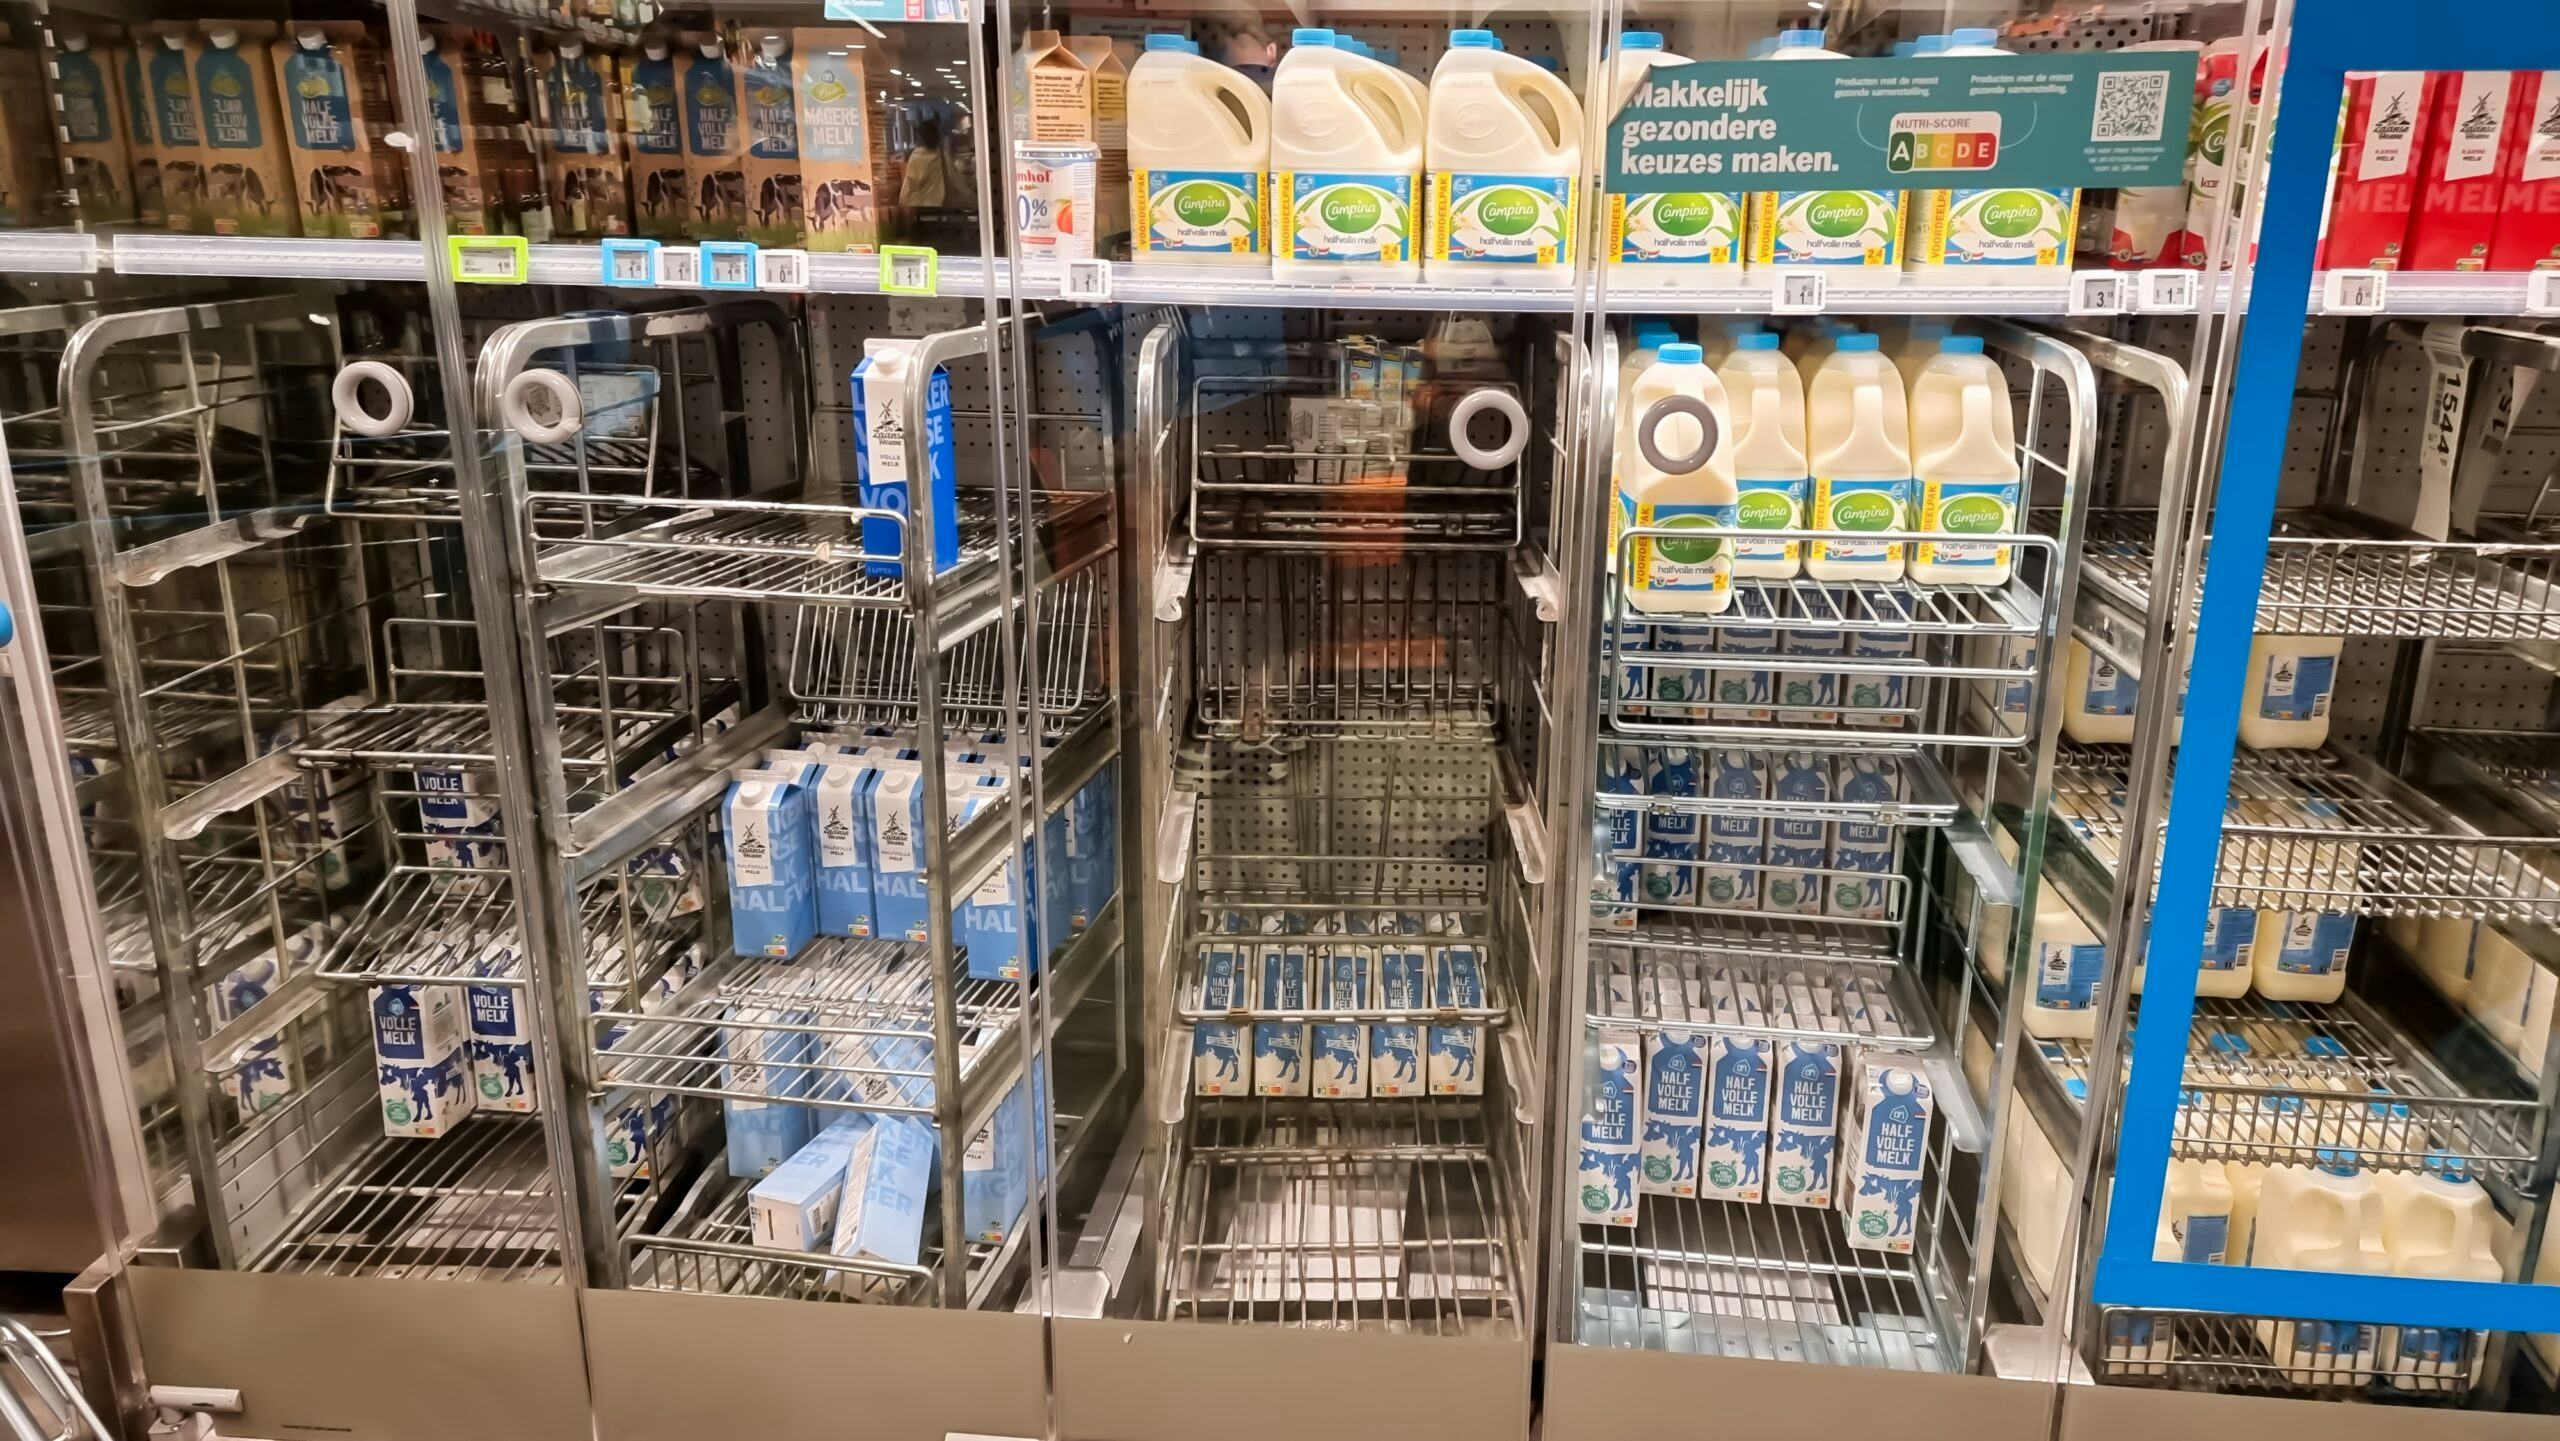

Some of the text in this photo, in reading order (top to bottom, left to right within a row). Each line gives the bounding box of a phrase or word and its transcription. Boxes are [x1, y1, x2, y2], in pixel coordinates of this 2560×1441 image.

[1626, 78, 1768, 112] Makkelijk
[804, 107, 859, 126] MAGERE
[1896, 118, 1971, 129] NUTRI-SCORE
[813, 126, 854, 145] MELK
[1622, 112, 1777, 147] gezondere
[1891, 141, 1990, 161] A B C D E
[1621, 145, 1839, 175] keuzes maken.
[1138, 174, 1146, 246] VOORDEELPAK
[1178, 196, 1225, 215] Campina
[1325, 200, 1376, 221] Campina
[1483, 202, 1534, 222] Campina
[1282, 177, 1290, 253] VOORDEELPAK
[1436, 178, 1448, 255] VOORDEELPAK
[1658, 204, 1709, 223] Campina
[1811, 204, 1864, 224] Campina
[1984, 204, 2038, 224] Campina
[1178, 228, 1228, 237] halfvolle melk
[1609, 193, 1622, 257] VOORDEELP
[1761, 192, 1775, 258] VOORDEELP
[1323, 235, 1378, 244] halfvolle melk
[1480, 236, 1534, 246] halfvolle melk
[1654, 238, 1709, 247] halfvolle melk
[1806, 239, 1863, 248] halfvolle melk
[1979, 240, 2035, 249] halfvolle melk
[2437, 373, 2462, 455] 1544
[1737, 504, 1787, 522] Campina
[1813, 482, 1827, 555] VODEELPAK
[1837, 505, 1889, 524] Campina
[1946, 509, 1999, 528] Campina
[1921, 485, 1937, 558] VODEELPAK
[1637, 507, 1650, 583] VOORDEEPAK
[1657, 565, 1716, 574] halfvolle melk
[422, 777, 459, 791] VOLLE
[1659, 816, 1687, 830] MELK
[1720, 819, 1750, 832] MELK
[1783, 822, 1813, 835] MELK
[1850, 825, 1879, 839] MELK
[473, 995, 509, 1009] VOLLE
[379, 1016, 416, 1031] VOLLE
[477, 1009, 509, 1023] MELK
[383, 1031, 415, 1045] MELK
[1661, 1071, 1691, 1085] HALF
[1726, 1075, 1756, 1090] HALF
[1657, 1084, 1693, 1098] VOLLE
[1794, 1081, 1825, 1094] HALF
[1722, 1089, 1758, 1103] VOLLE
[1790, 1094, 1827, 1108] VOLLE
[1658, 1098, 1690, 1112] MELK
[1723, 1103, 1755, 1116] MELK
[1791, 1108, 1824, 1121] MELK
[1591, 1126, 1624, 1140] MELK
[1881, 1122, 1913, 1138] HALF
[1876, 1136, 1915, 1152] VOLLE
[1876, 1150, 1911, 1165] MELK
